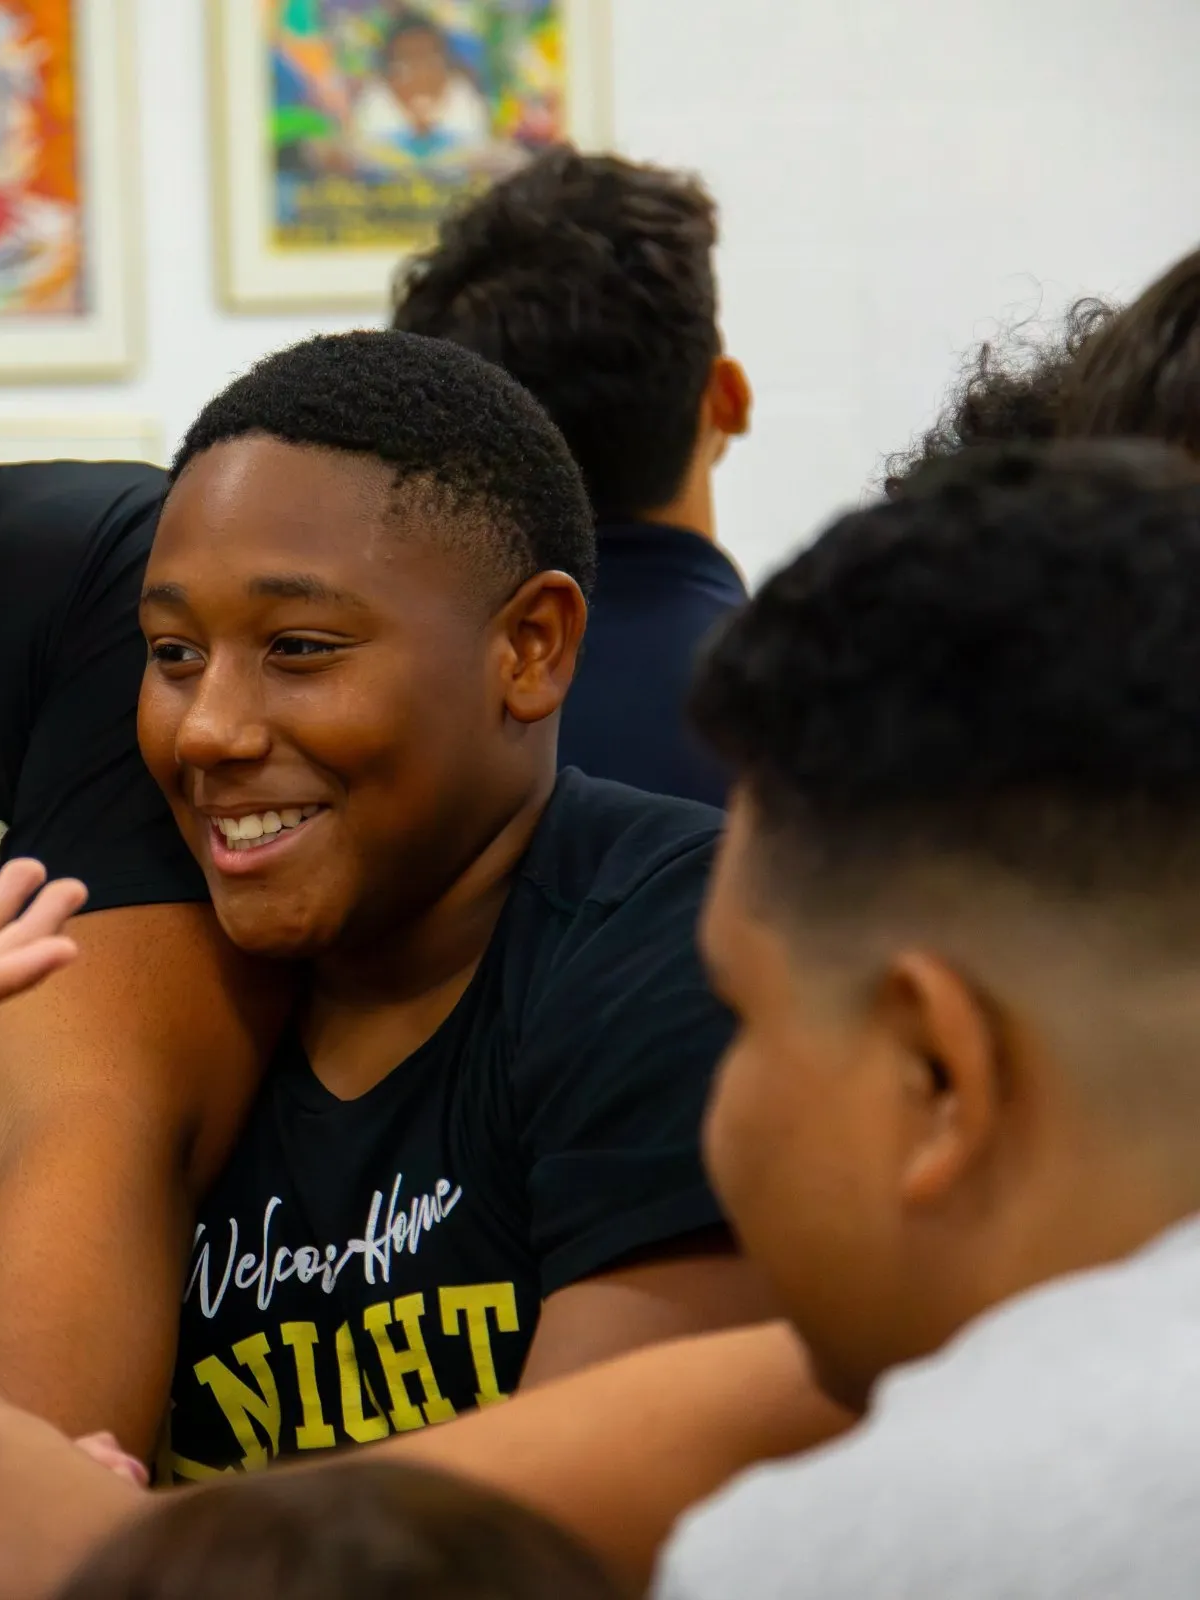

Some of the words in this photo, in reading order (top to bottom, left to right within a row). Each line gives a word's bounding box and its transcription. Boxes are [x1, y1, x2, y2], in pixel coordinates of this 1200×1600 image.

[185, 1196, 355, 1318] Welcoe
[348, 1173, 462, 1284] Home
[166, 1281, 519, 1484] NIHT
